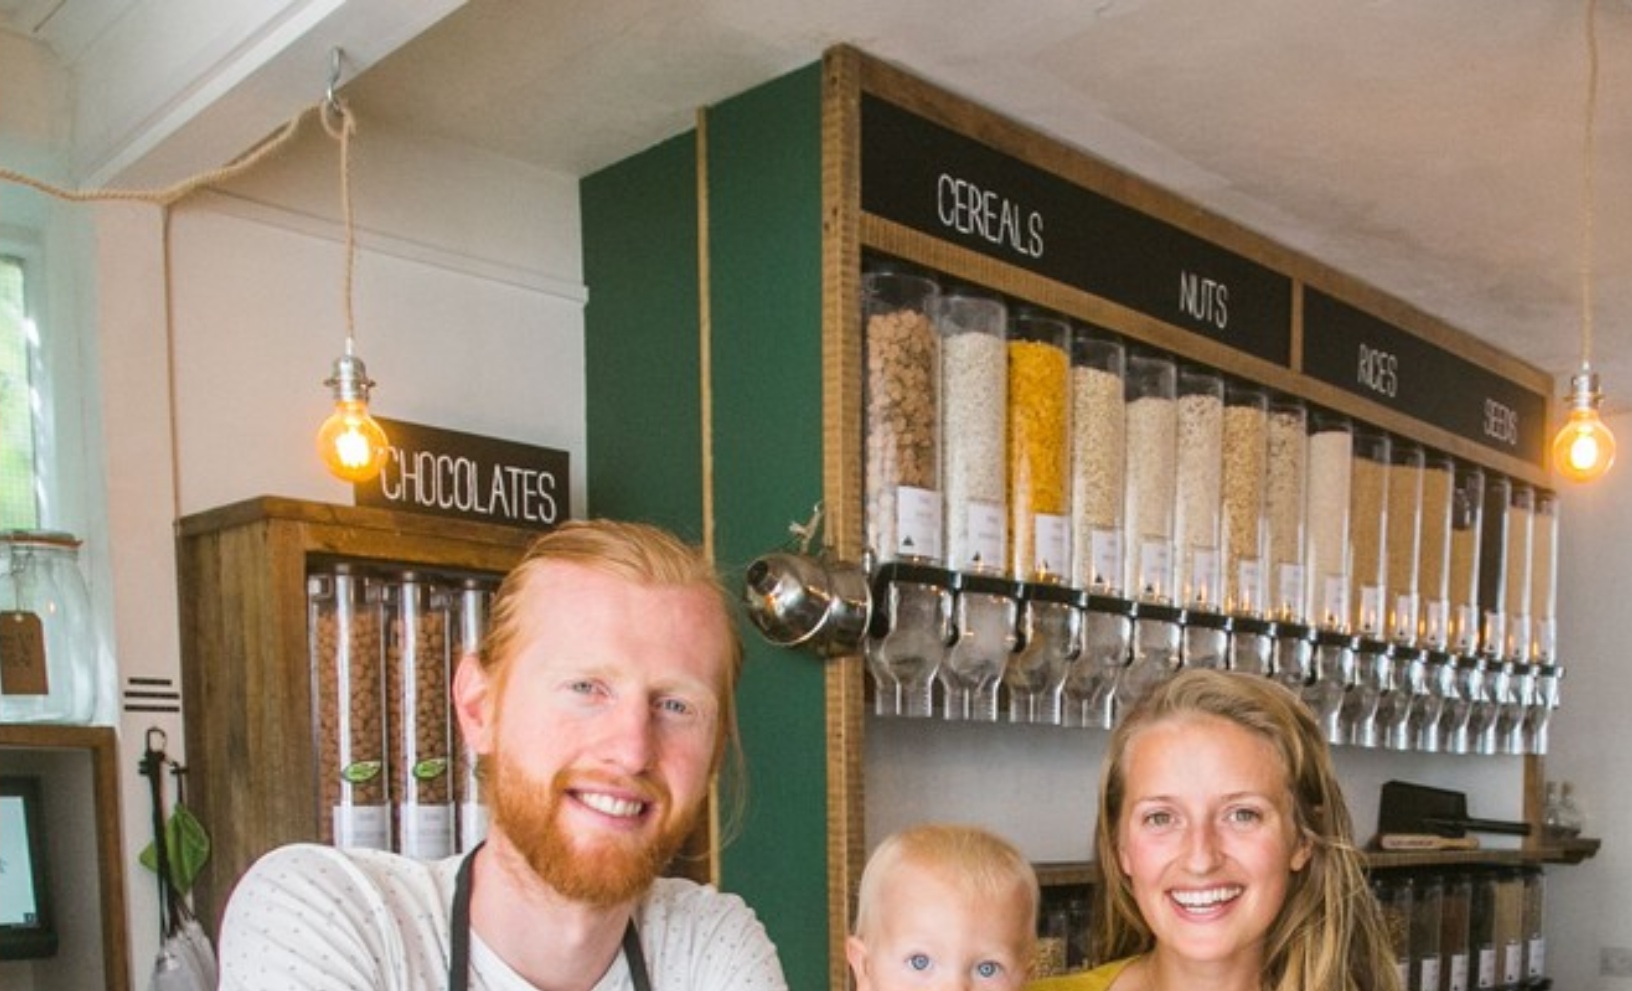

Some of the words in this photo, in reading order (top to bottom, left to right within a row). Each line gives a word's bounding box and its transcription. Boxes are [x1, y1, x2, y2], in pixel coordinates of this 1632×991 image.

[937, 173, 1044, 258] CEREALS
[1179, 270, 1228, 329] NUTS
[1357, 343, 1399, 398] RICES
[378, 446, 557, 524] CHOCOLATES
